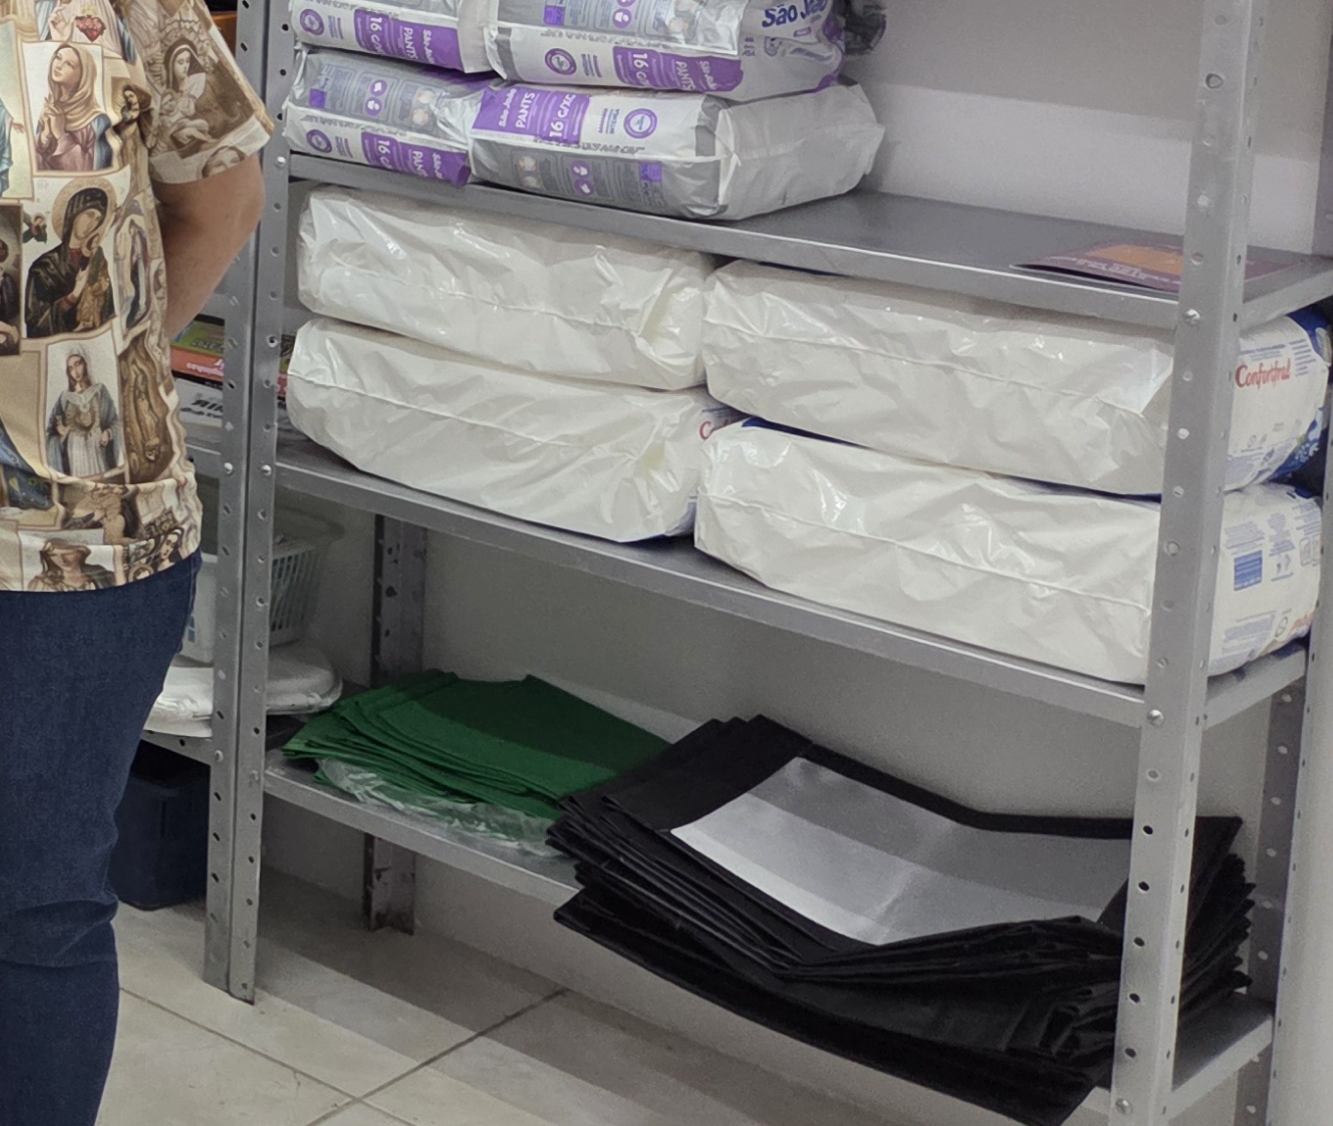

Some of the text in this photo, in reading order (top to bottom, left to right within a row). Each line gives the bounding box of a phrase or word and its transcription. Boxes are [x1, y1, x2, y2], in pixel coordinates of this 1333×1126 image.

[369, 16, 382, 32] 16
[761, 3, 798, 28] São
[403, 26, 419, 60] PANTS
[632, 53, 648, 69] 16
[676, 61, 696, 91] PANTS
[515, 92, 536, 129] PANTS
[549, 120, 564, 138] 16
[376, 139, 391, 155] 16
